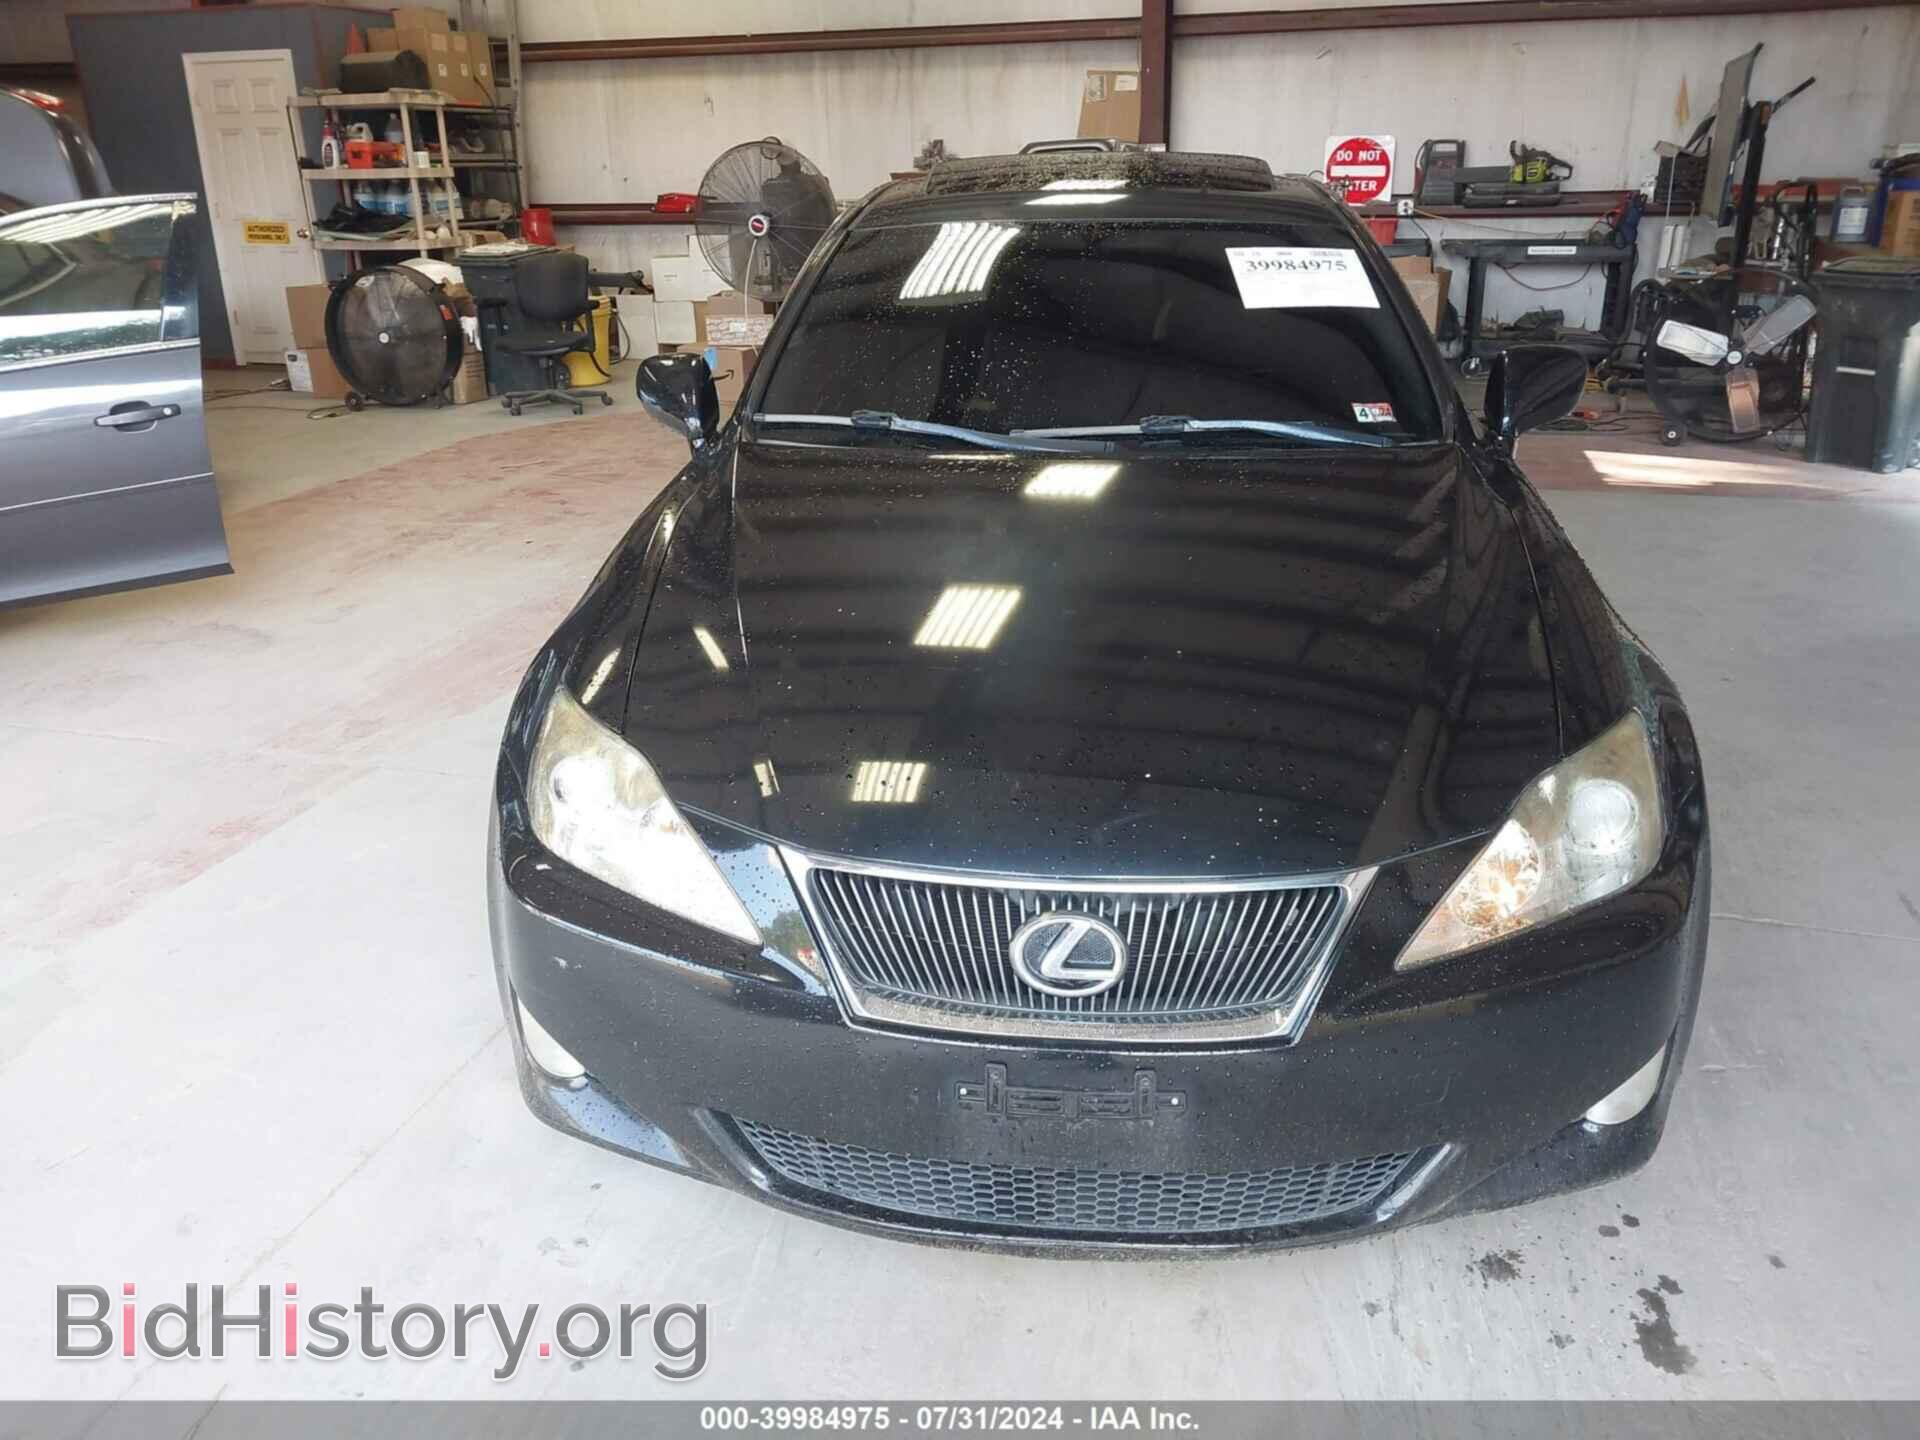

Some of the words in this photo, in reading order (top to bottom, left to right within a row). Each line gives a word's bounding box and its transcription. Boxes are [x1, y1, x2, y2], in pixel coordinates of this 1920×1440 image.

[1336, 150, 1353, 162] DO
[1358, 150, 1382, 162] NOT
[1246, 259, 1348, 272] 39984975
[1359, 407, 1369, 419] 4
